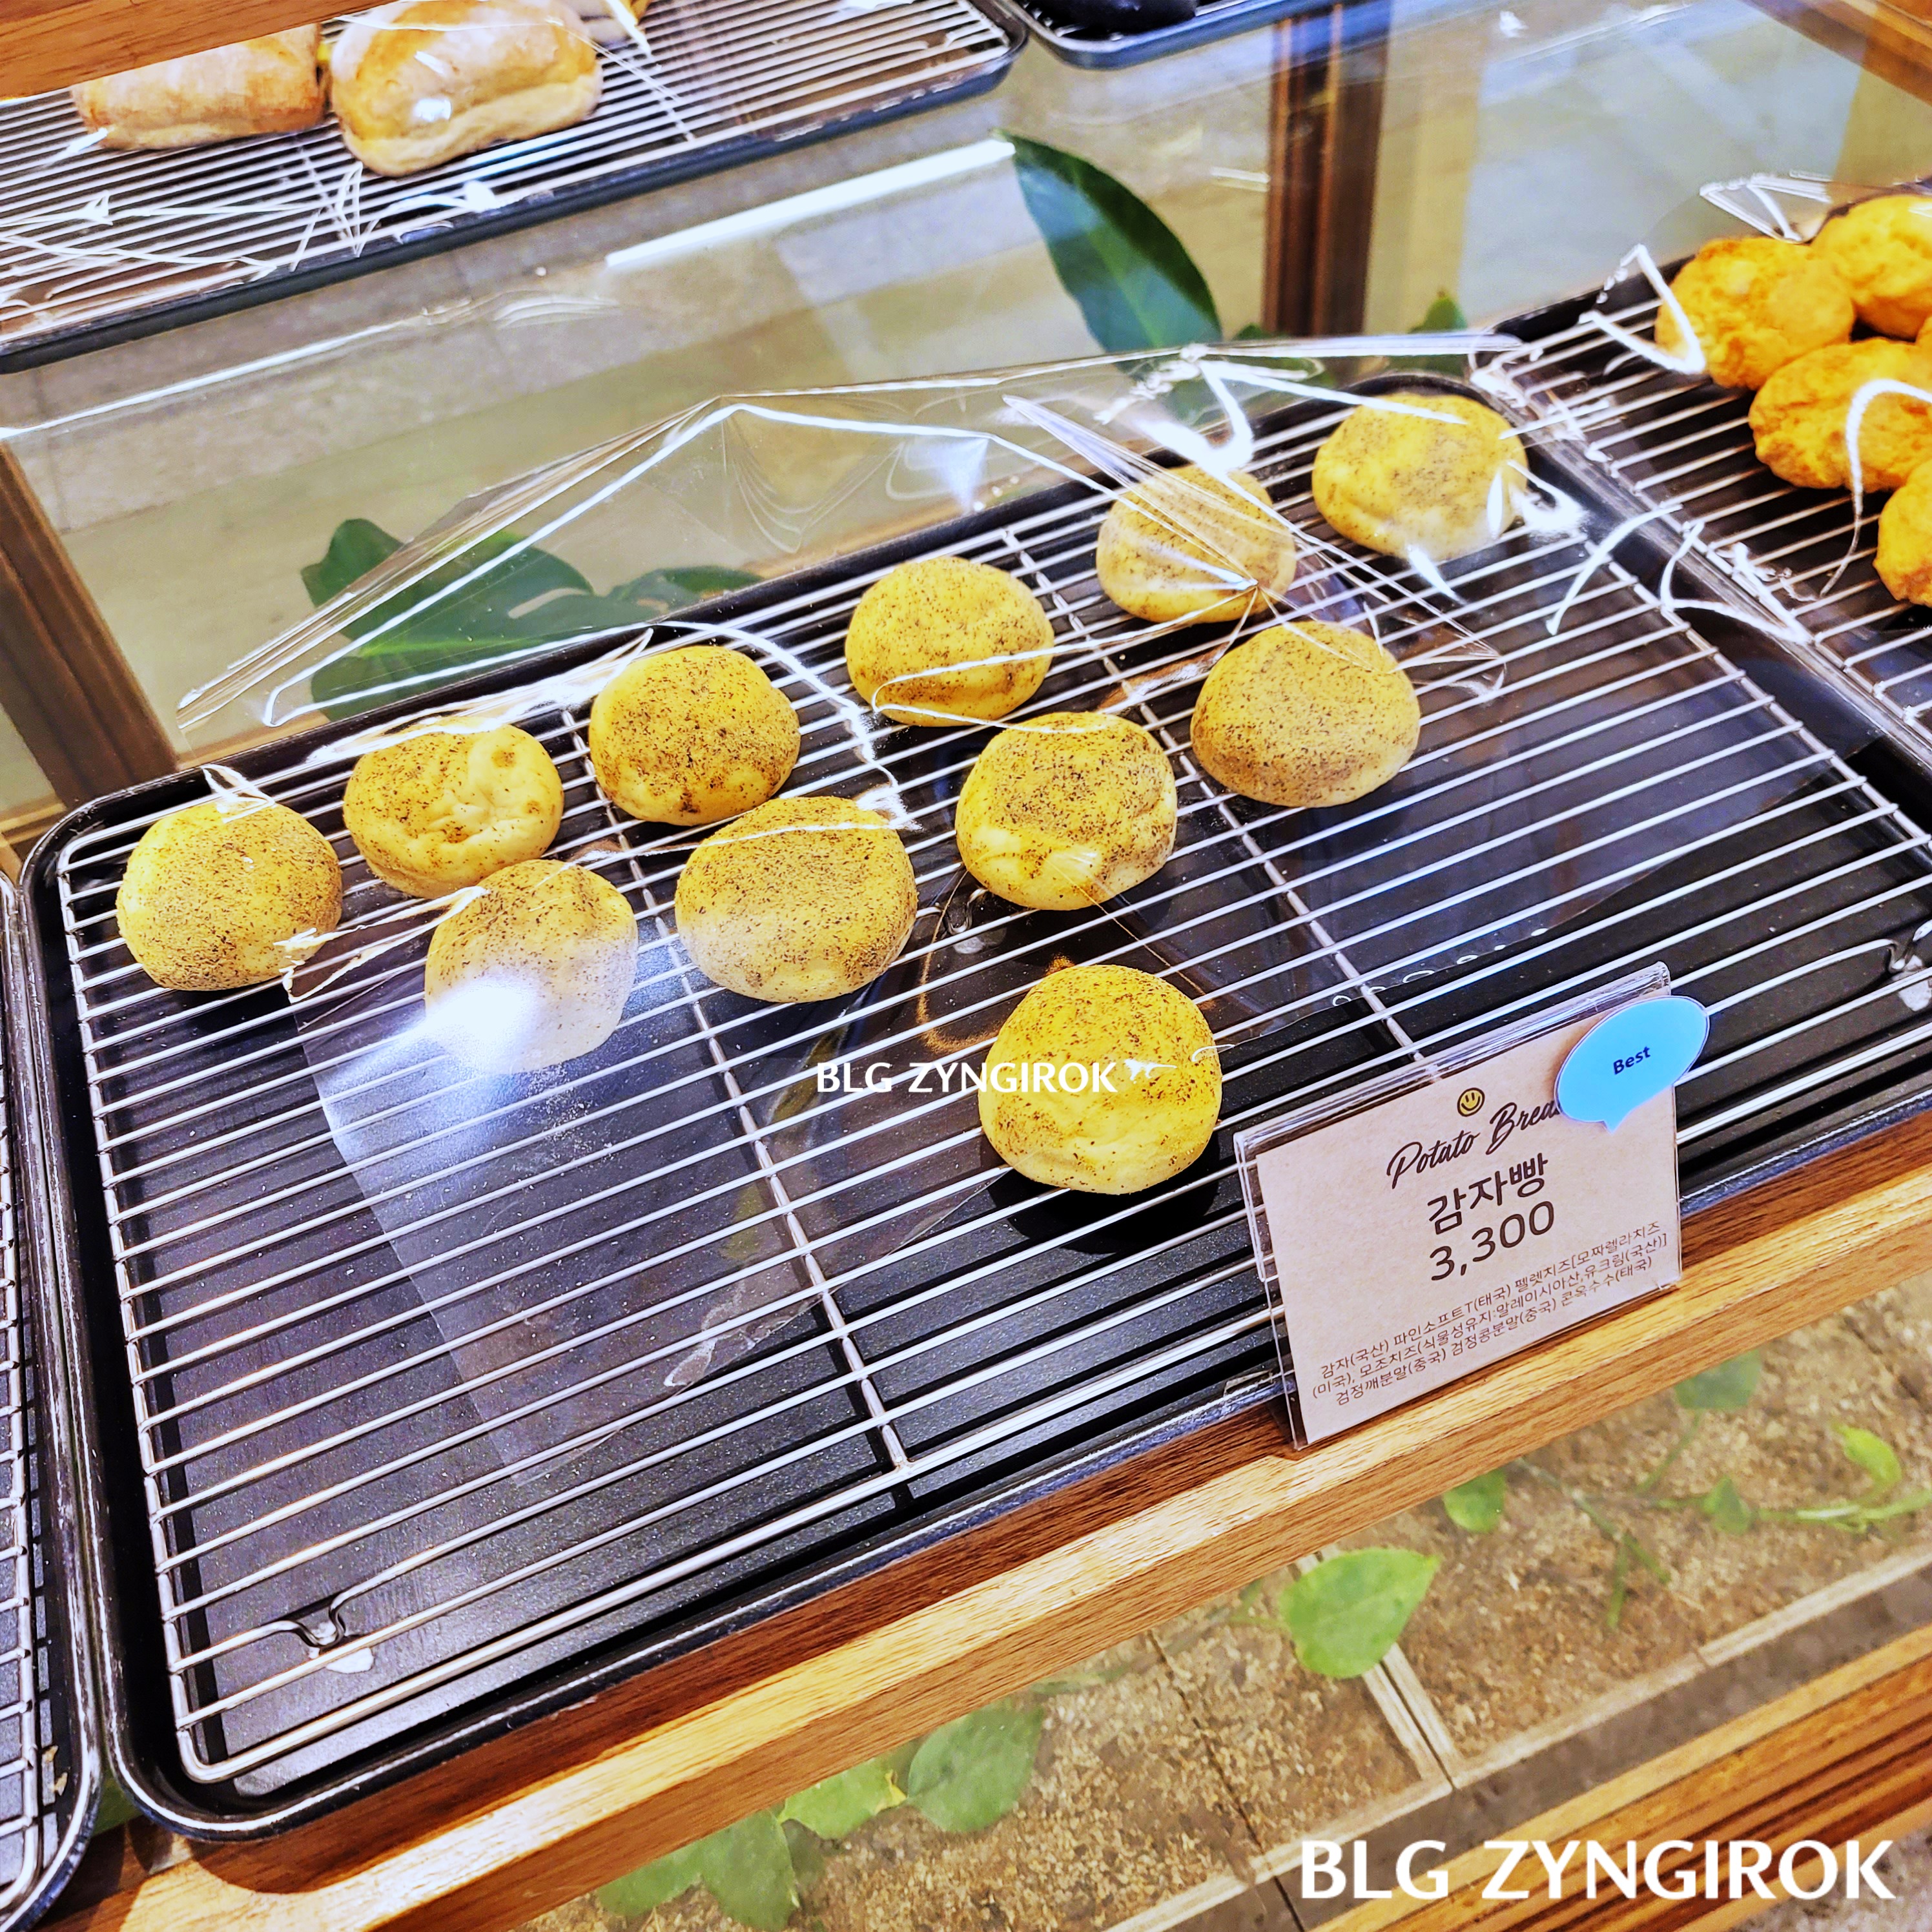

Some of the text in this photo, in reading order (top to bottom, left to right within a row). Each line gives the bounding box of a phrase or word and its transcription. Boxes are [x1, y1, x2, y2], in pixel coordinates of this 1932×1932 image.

[1613, 1045, 1651, 1075] Best
[1386, 1100, 1561, 1189] Potato Brea
[1427, 1153, 1548, 1235] 감자빵
[1430, 1201, 1554, 1281] 3,300
[1321, 1339, 1389, 1379] 감자(국산)
[1393, 1284, 1511, 1346] 파인소프트T(태국)
[1336, 1256, 1652, 1406] 검정깨분말(중국) 검정콩분말(중국) 콘옥수수(태국)
[1313, 1372, 1355, 1399] (미국),
